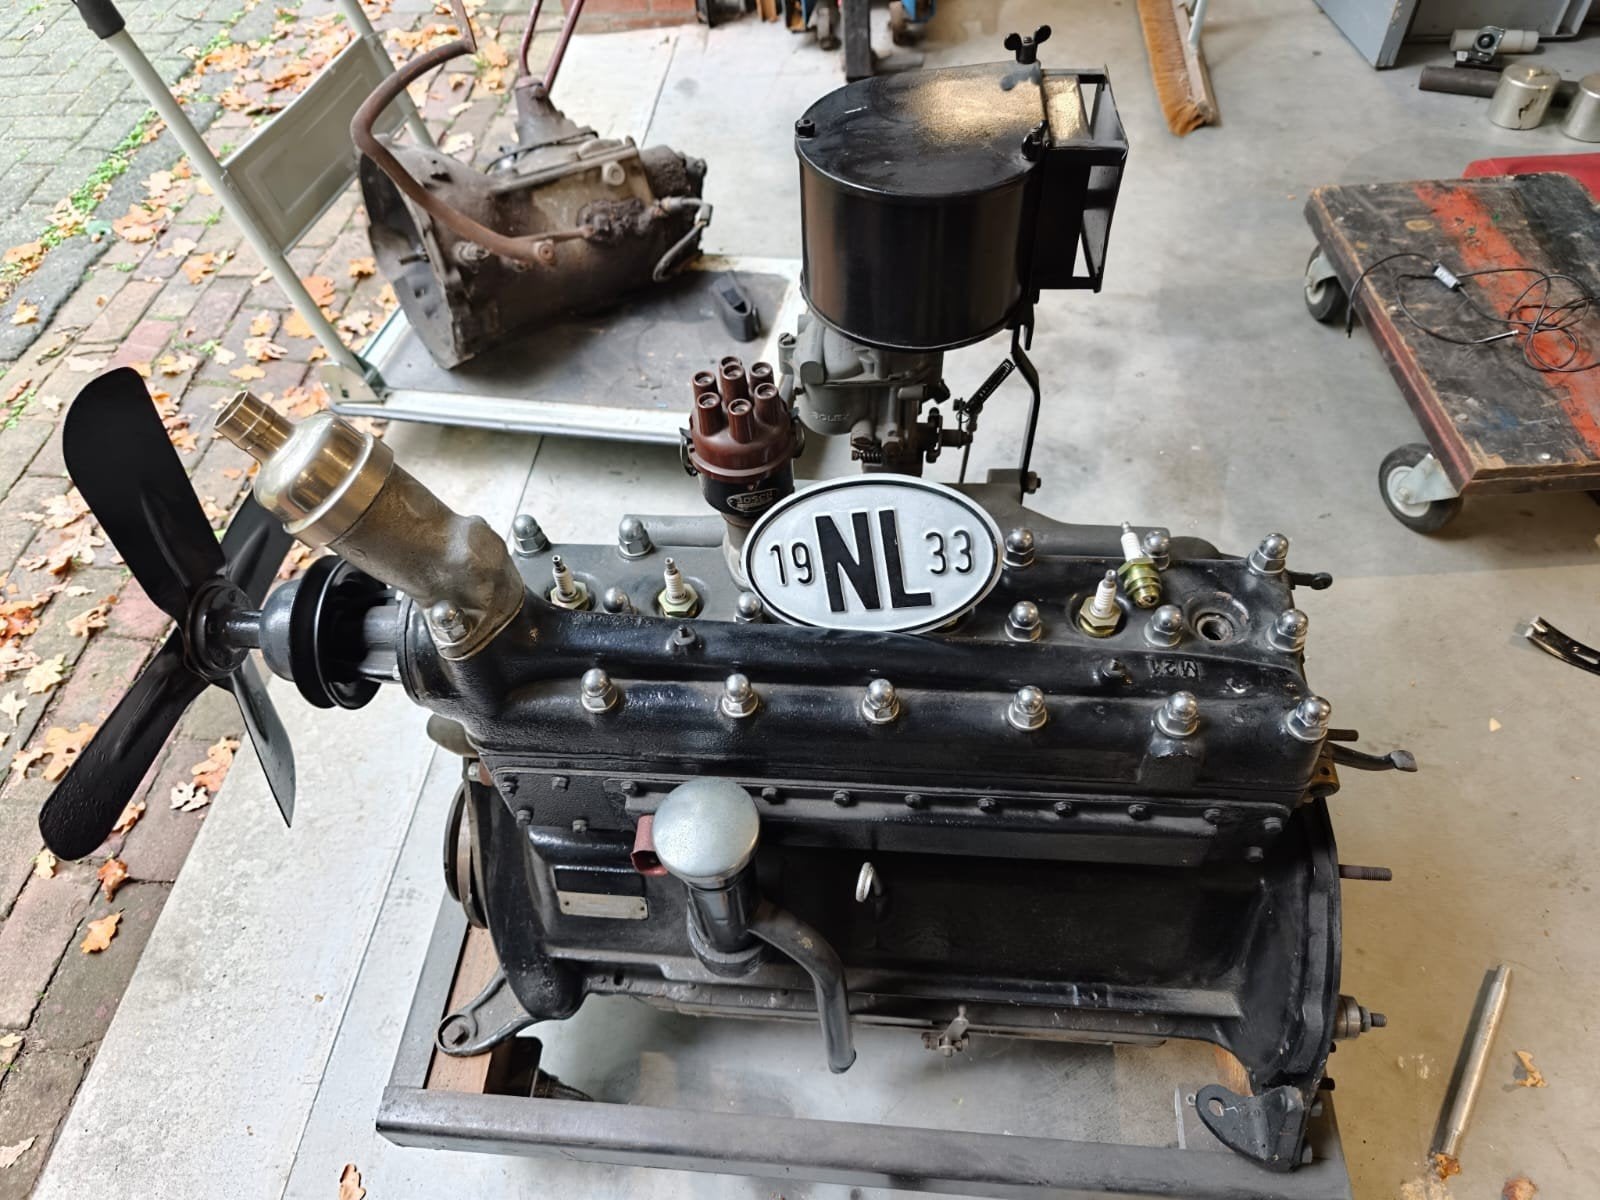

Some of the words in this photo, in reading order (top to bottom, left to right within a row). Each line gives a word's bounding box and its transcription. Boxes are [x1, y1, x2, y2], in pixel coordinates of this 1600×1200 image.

[770, 542, 813, 585] 19
[815, 509, 933, 613] NL
[925, 530, 973, 575] 33
